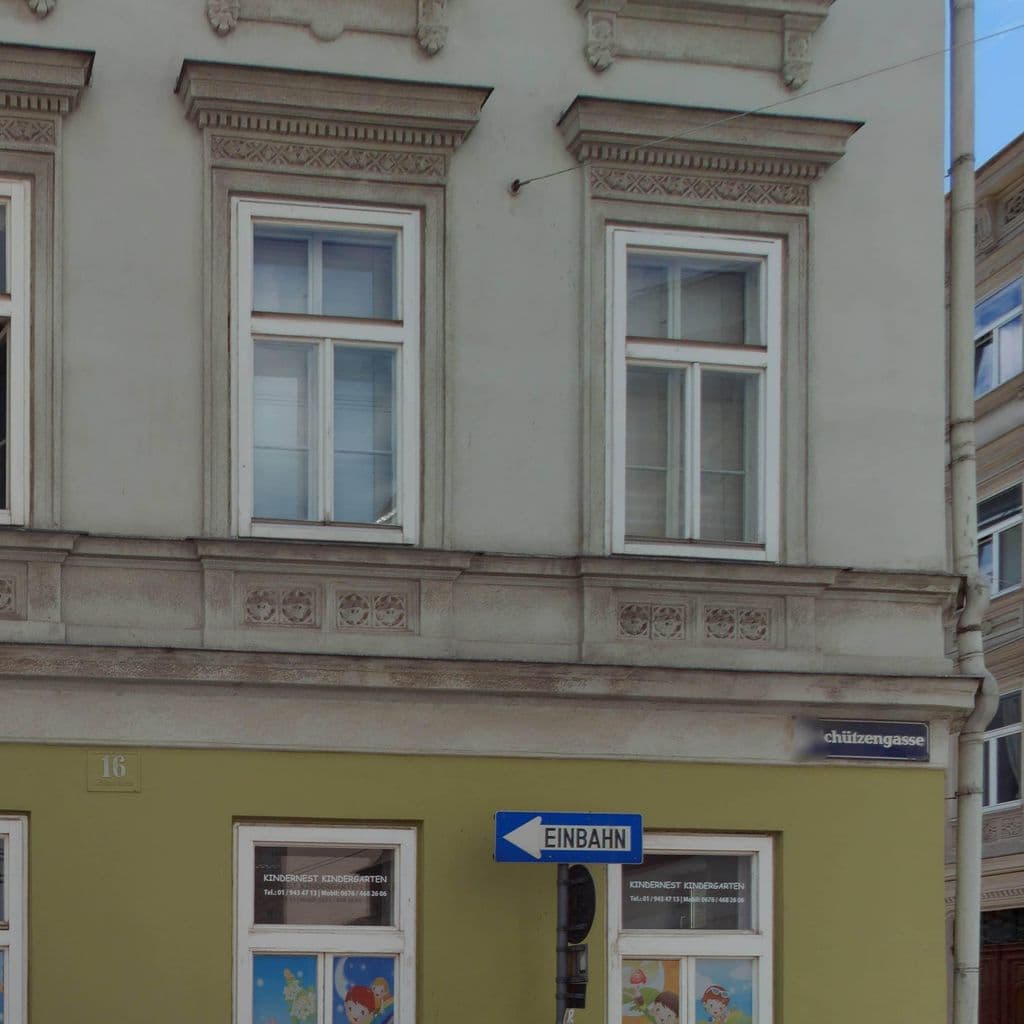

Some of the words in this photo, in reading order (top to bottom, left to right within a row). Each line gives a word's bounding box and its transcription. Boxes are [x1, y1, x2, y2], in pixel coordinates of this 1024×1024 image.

[821, 729, 925, 749] chützengasse
[101, 754, 128, 778] 16
[544, 827, 627, 849] EINBAHN
[263, 874, 319, 882] KINDERNEST
[321, 875, 387, 883] KINDERGARTEN
[629, 881, 682, 889] KINDERNEST
[683, 882, 745, 890] KINDERGARTEN
